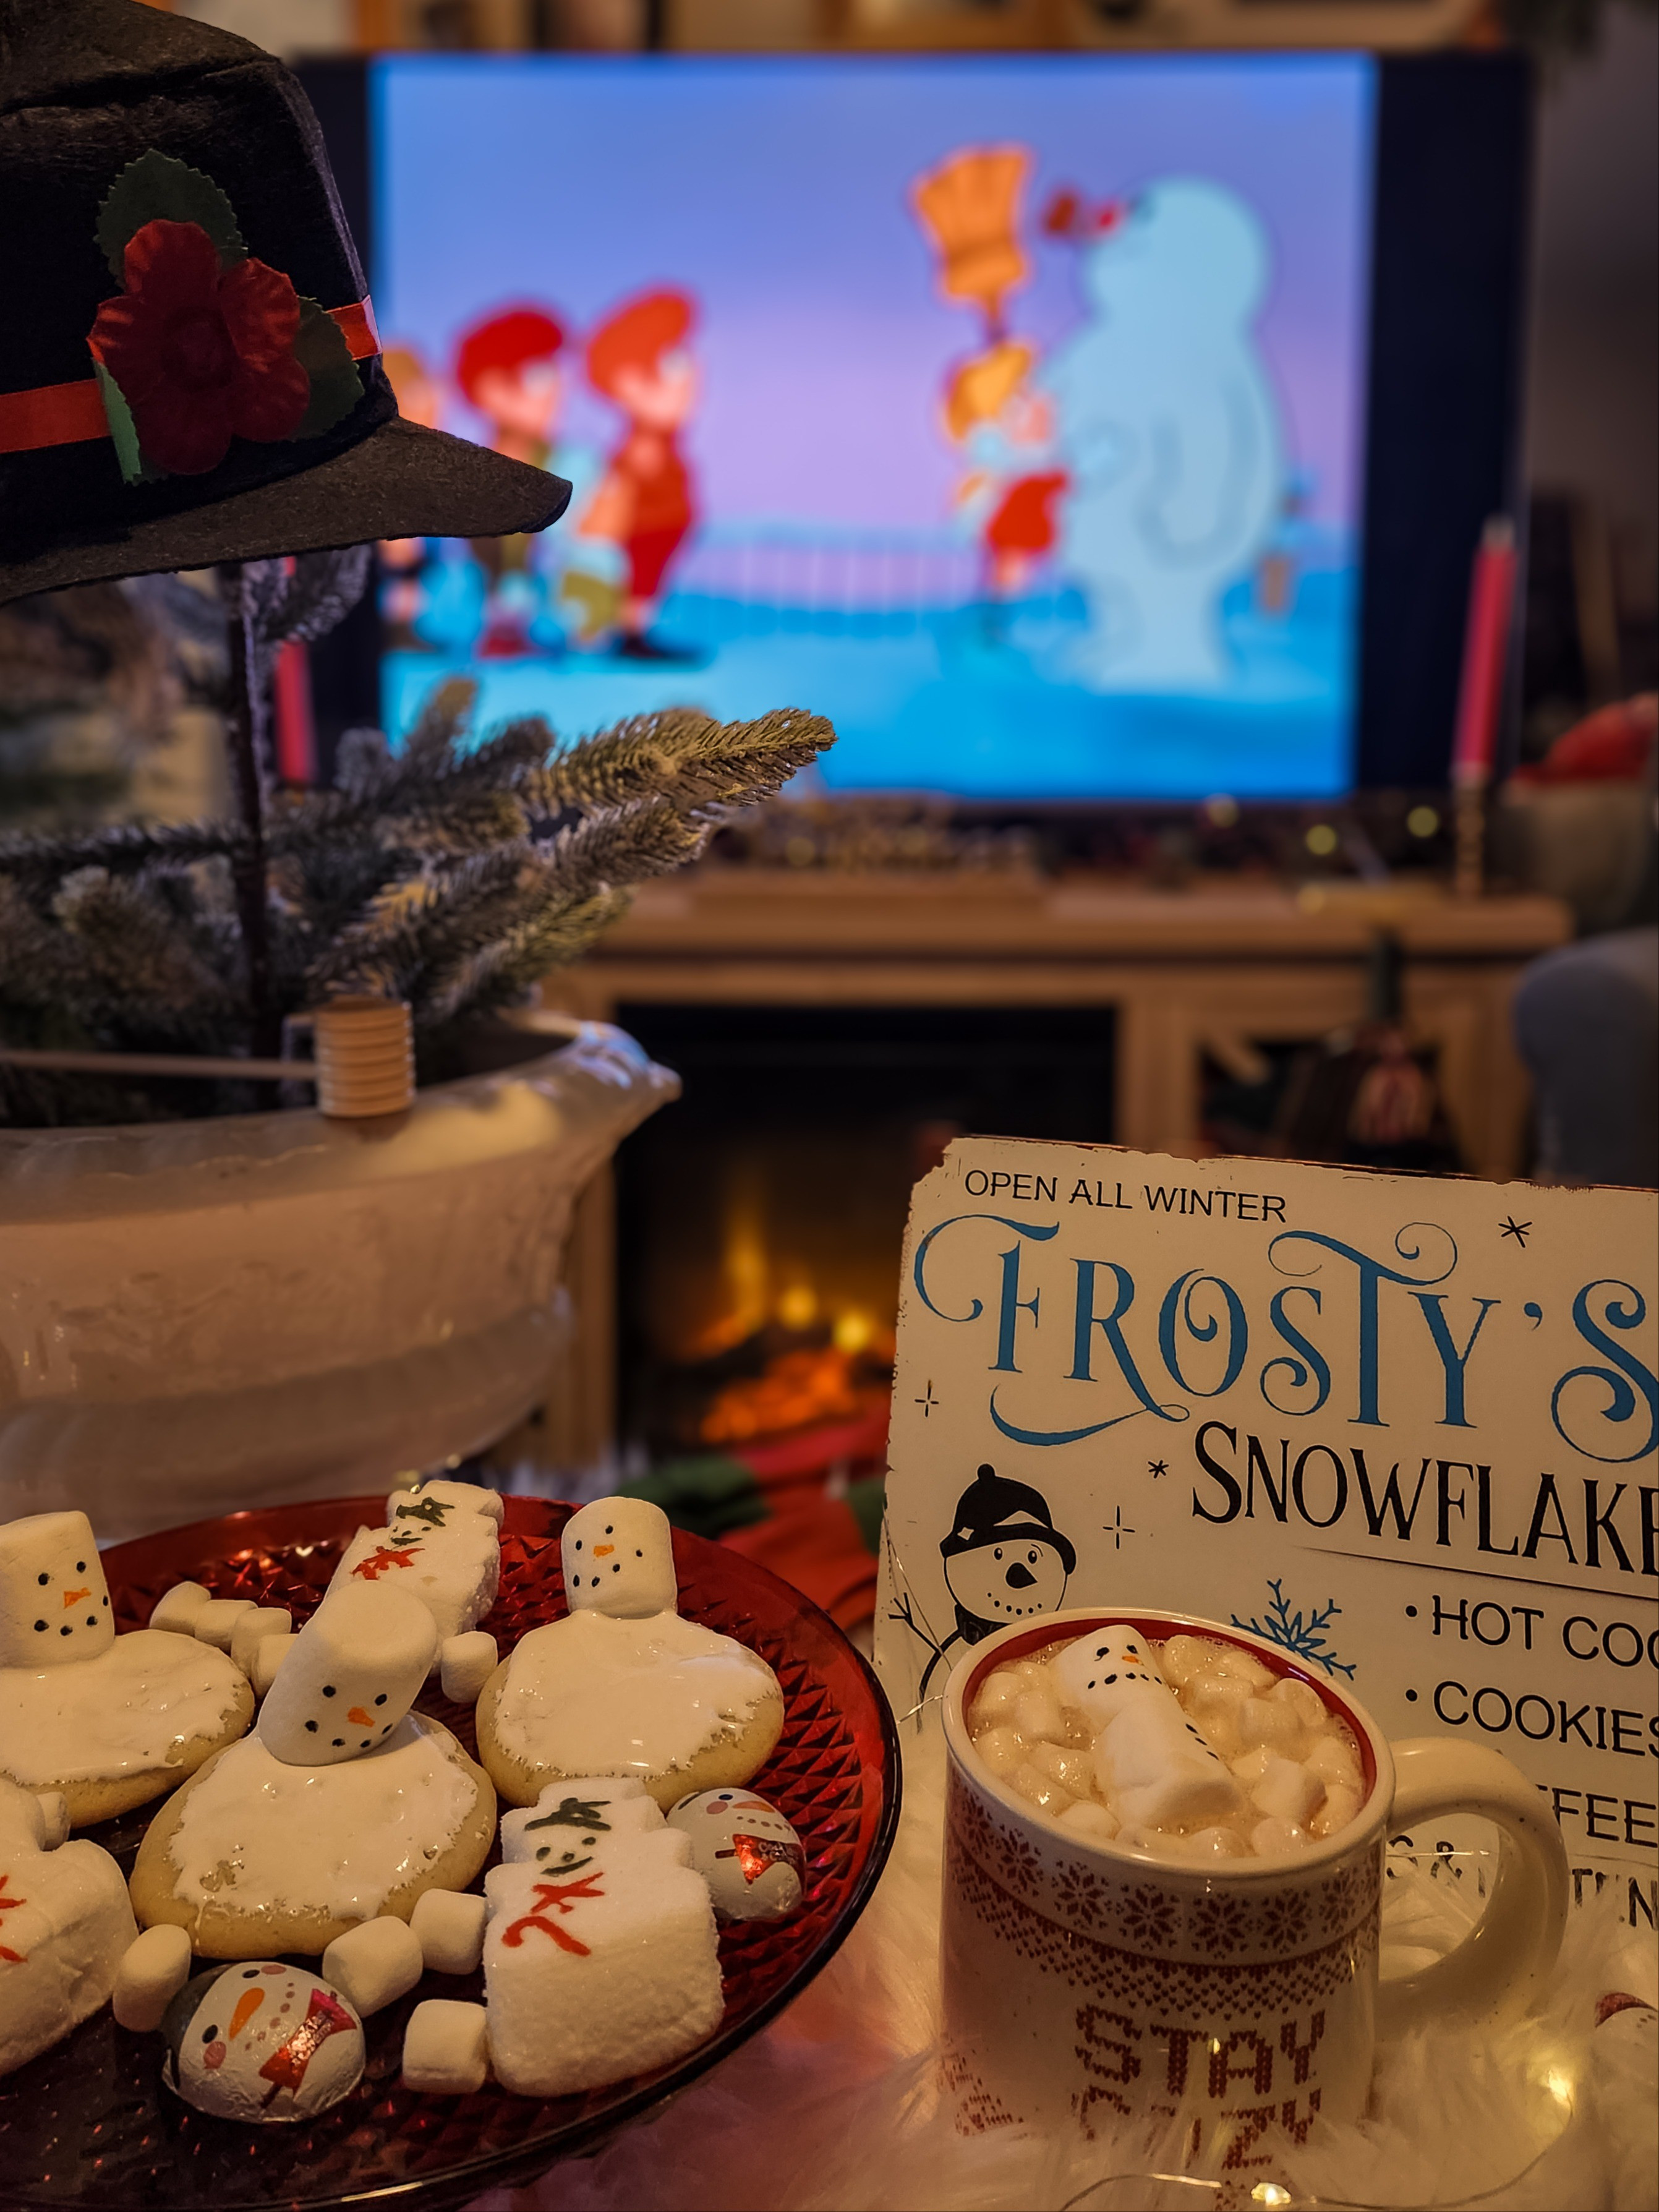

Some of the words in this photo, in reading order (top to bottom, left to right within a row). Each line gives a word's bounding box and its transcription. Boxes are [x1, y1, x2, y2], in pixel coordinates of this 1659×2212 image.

[965, 1169, 1058, 1202] OPEN
[1068, 1179, 1133, 1210] ALL
[1143, 1185, 1286, 1223] WINTER
[914, 1214, 1658, 1463] FROSTY'S
[1433, 1595, 1544, 1650] HOT
[1563, 1615, 1658, 1670] CO
[1536, 1784, 1658, 1848] FEE
[1075, 2004, 1325, 2098] STAY
